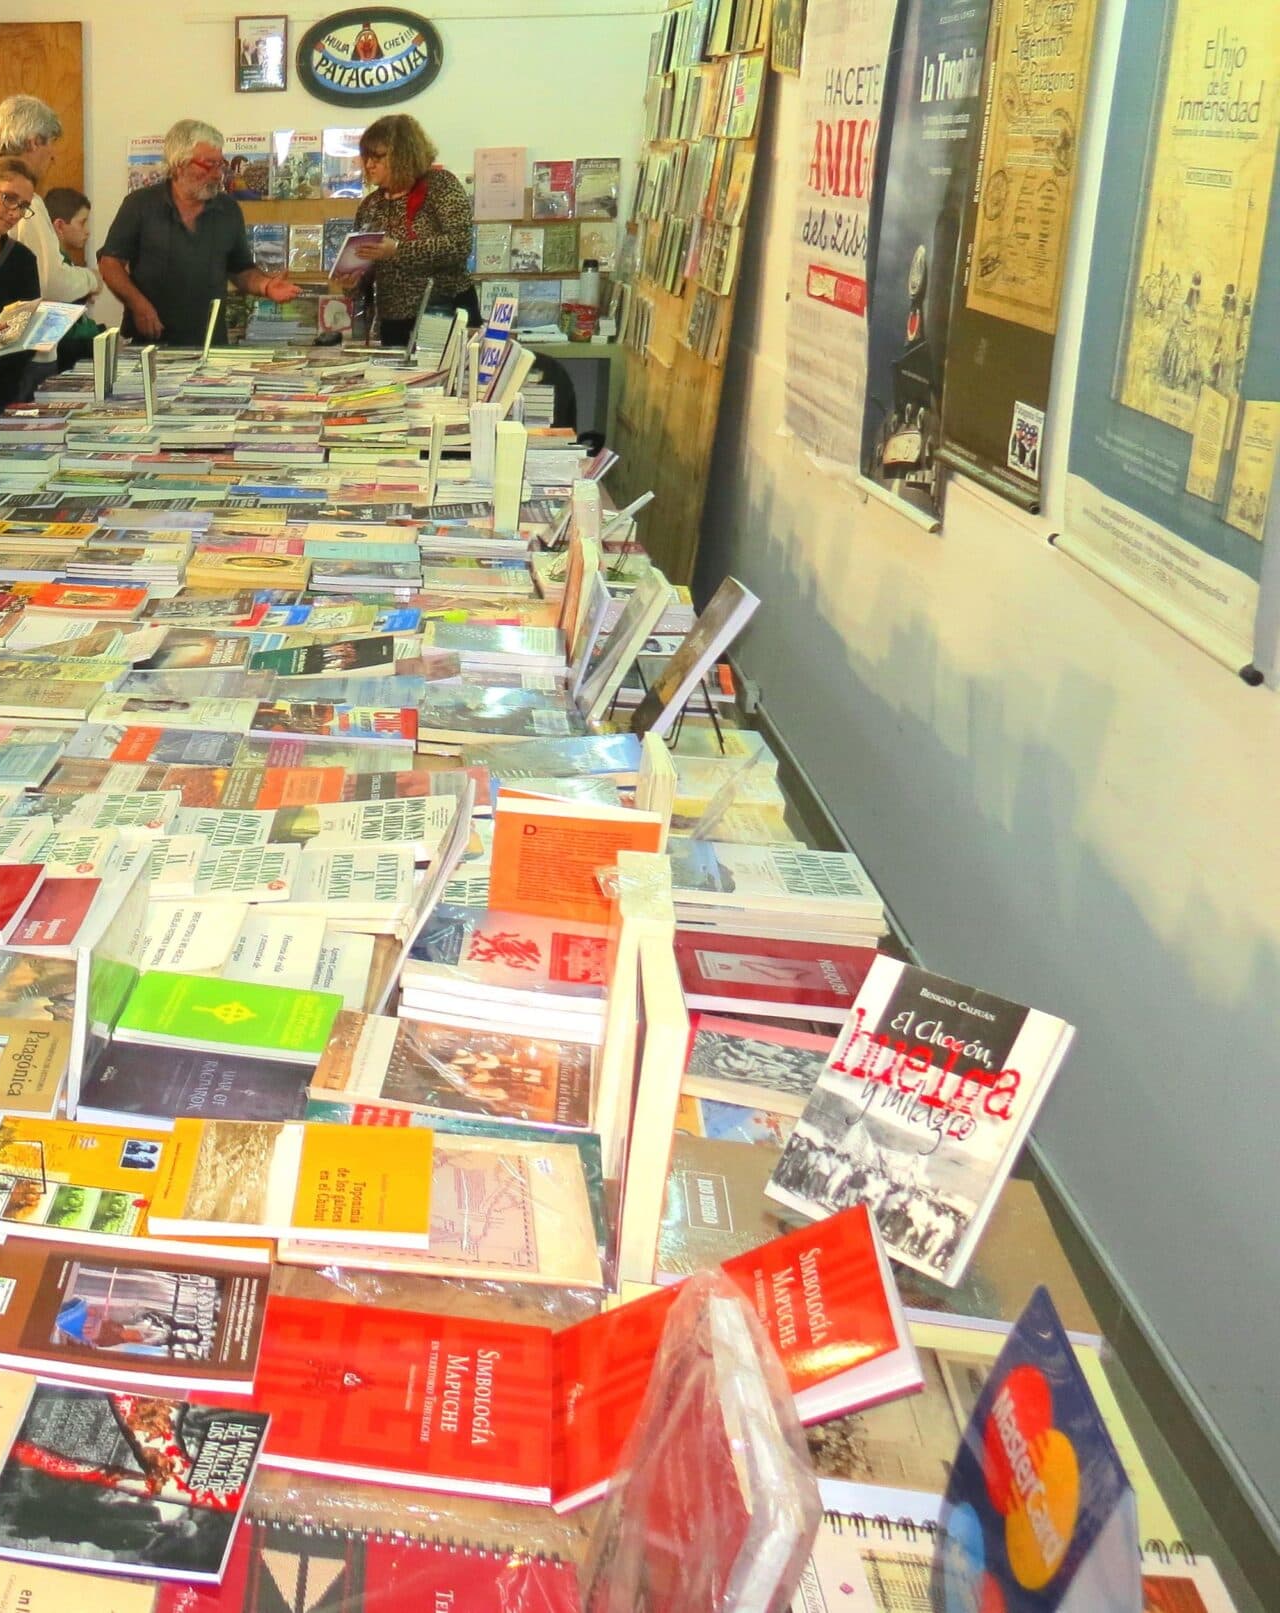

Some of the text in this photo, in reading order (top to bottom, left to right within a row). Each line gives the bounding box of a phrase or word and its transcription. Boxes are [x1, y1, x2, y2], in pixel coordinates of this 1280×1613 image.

[314, 46, 428, 89] PATAGONIA
[1204, 26, 1248, 77] El hijo
[920, 55, 935, 103] La
[1177, 79, 1265, 124] inmensidad
[493, 302, 514, 324] VISA
[480, 347, 500, 368] VISA
[359, 820, 383, 839] POLO
[211, 850, 241, 888] PATAGONIA
[326, 855, 353, 898] PATAGONIA
[353, 871, 374, 880] EN
[374, 854, 398, 899] AVENTURAS
[919, 987, 957, 1008] BENIGNO
[890, 1011, 994, 1069] El Chocón,
[6, 1032, 49, 1096] Patagónica
[348, 1181, 368, 1223] Toponimia
[770, 1267, 796, 1346] MAPUCHE
[798, 1247, 829, 1342] SIMBOLOGÍA
[438, 1355, 470, 1431] MAPUCHE
[469, 1350, 501, 1444] SIMBOLOGÍA
[185, 1421, 226, 1490] LOS MARTIRES
[204, 1424, 242, 1494] DEL VALLE DE
[222, 1425, 257, 1494] LA MASACRE
